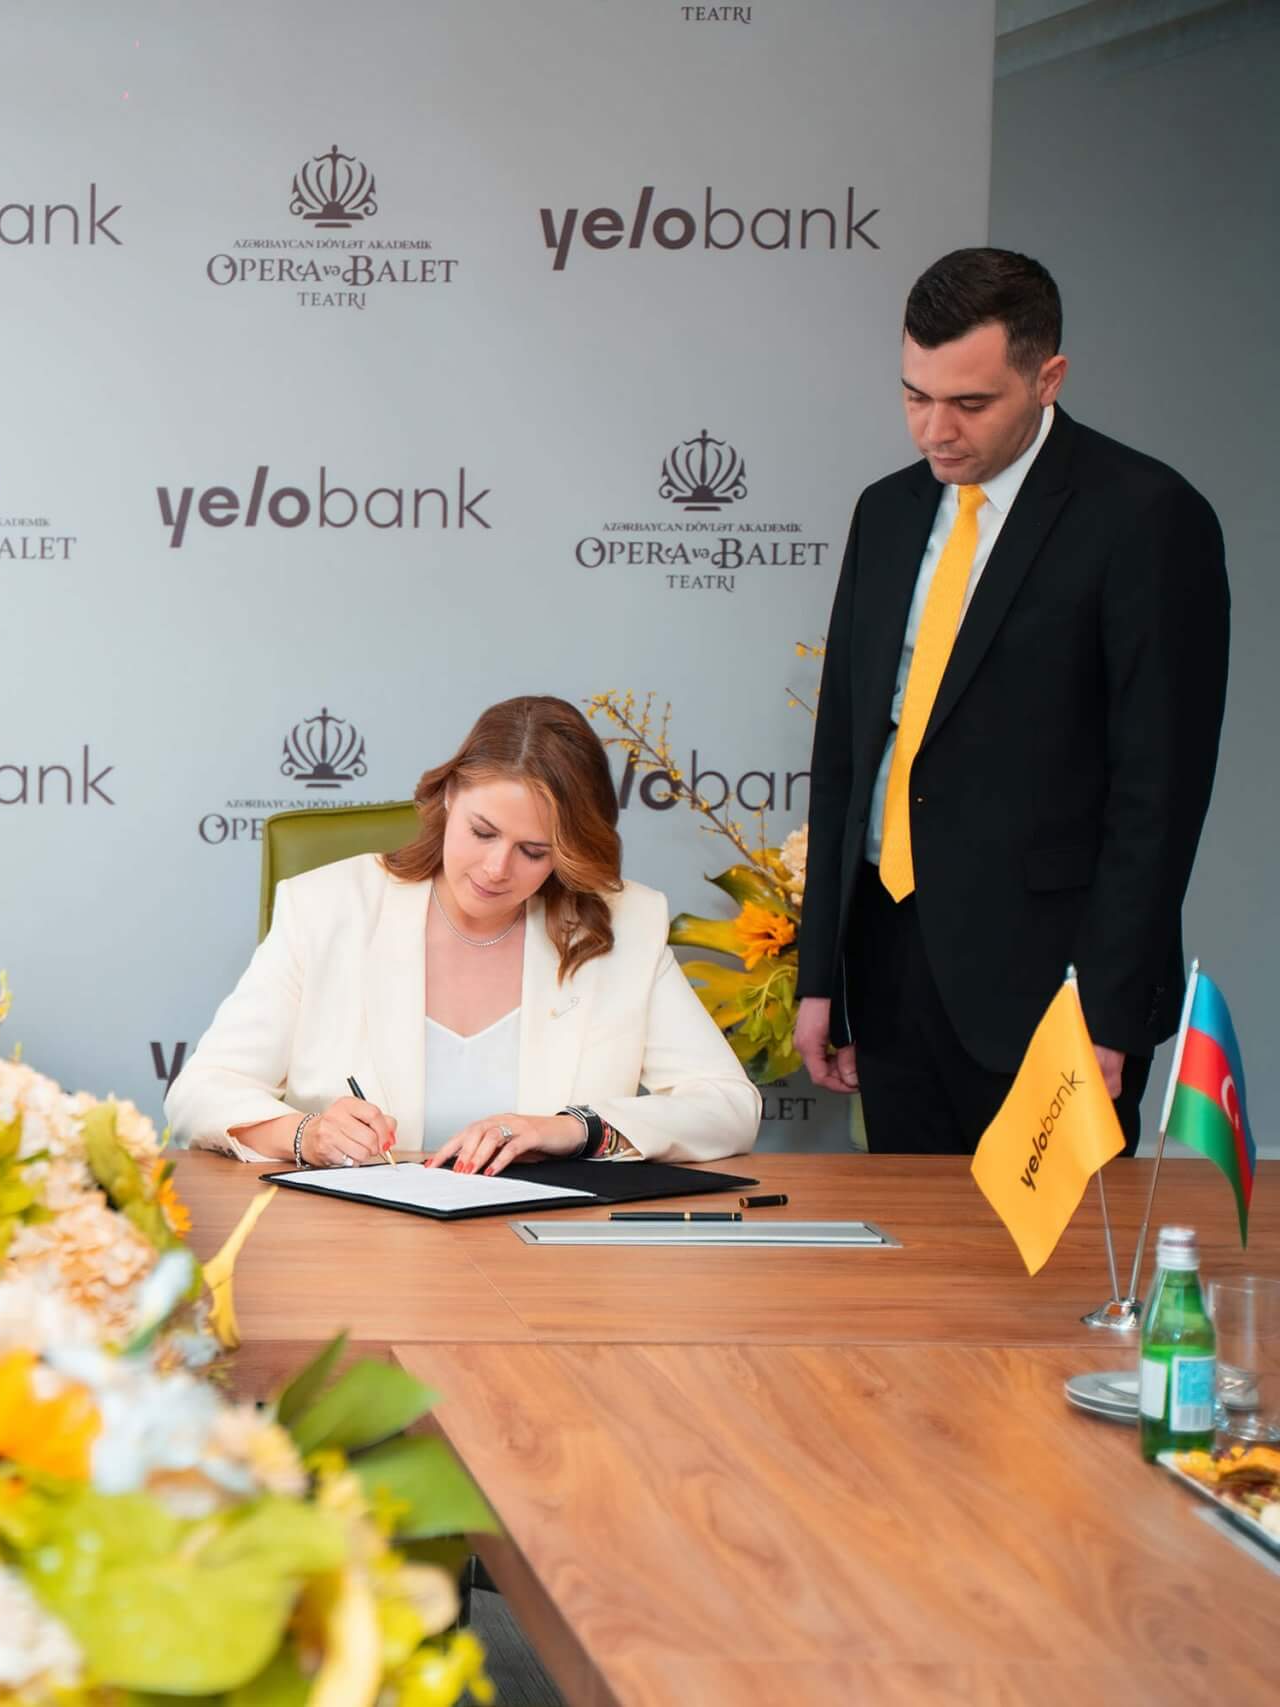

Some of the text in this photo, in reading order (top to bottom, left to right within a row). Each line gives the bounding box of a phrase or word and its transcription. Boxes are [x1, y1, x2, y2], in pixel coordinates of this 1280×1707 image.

[540, 186, 880, 270] yelobank
[207, 254, 322, 285] OPERA
[342, 255, 458, 286] BALET
[157, 466, 492, 548] yelobank
[576, 537, 691, 568] OPERA
[711, 538, 829, 568] BALET
[1020, 1070, 1086, 1192] yelobank
